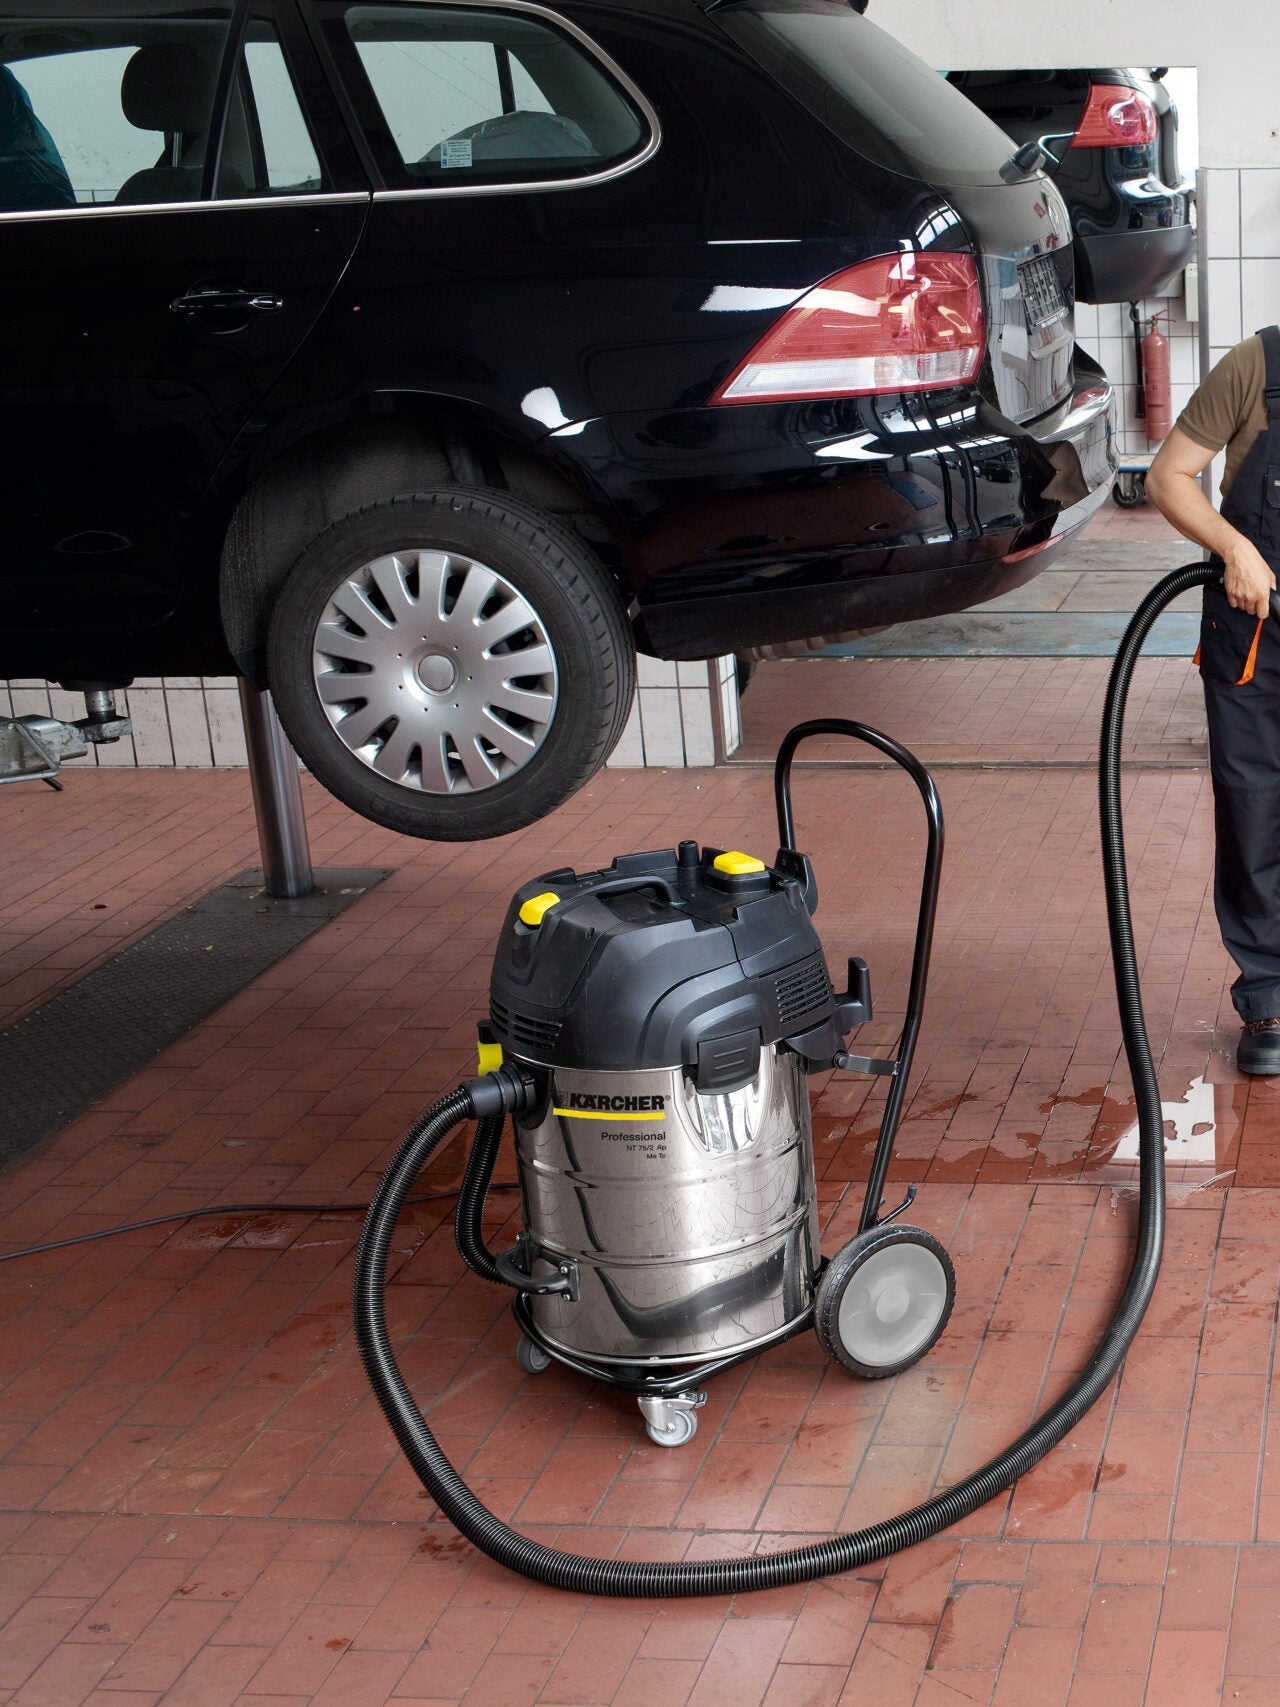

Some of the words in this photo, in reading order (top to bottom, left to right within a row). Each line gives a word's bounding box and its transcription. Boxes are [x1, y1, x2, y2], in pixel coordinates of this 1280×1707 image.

[601, 1131, 666, 1141] Professional
[627, 1144, 636, 1152] NT
[638, 1144, 654, 1152] 75/2
[657, 1144, 667, 1152] Ap
